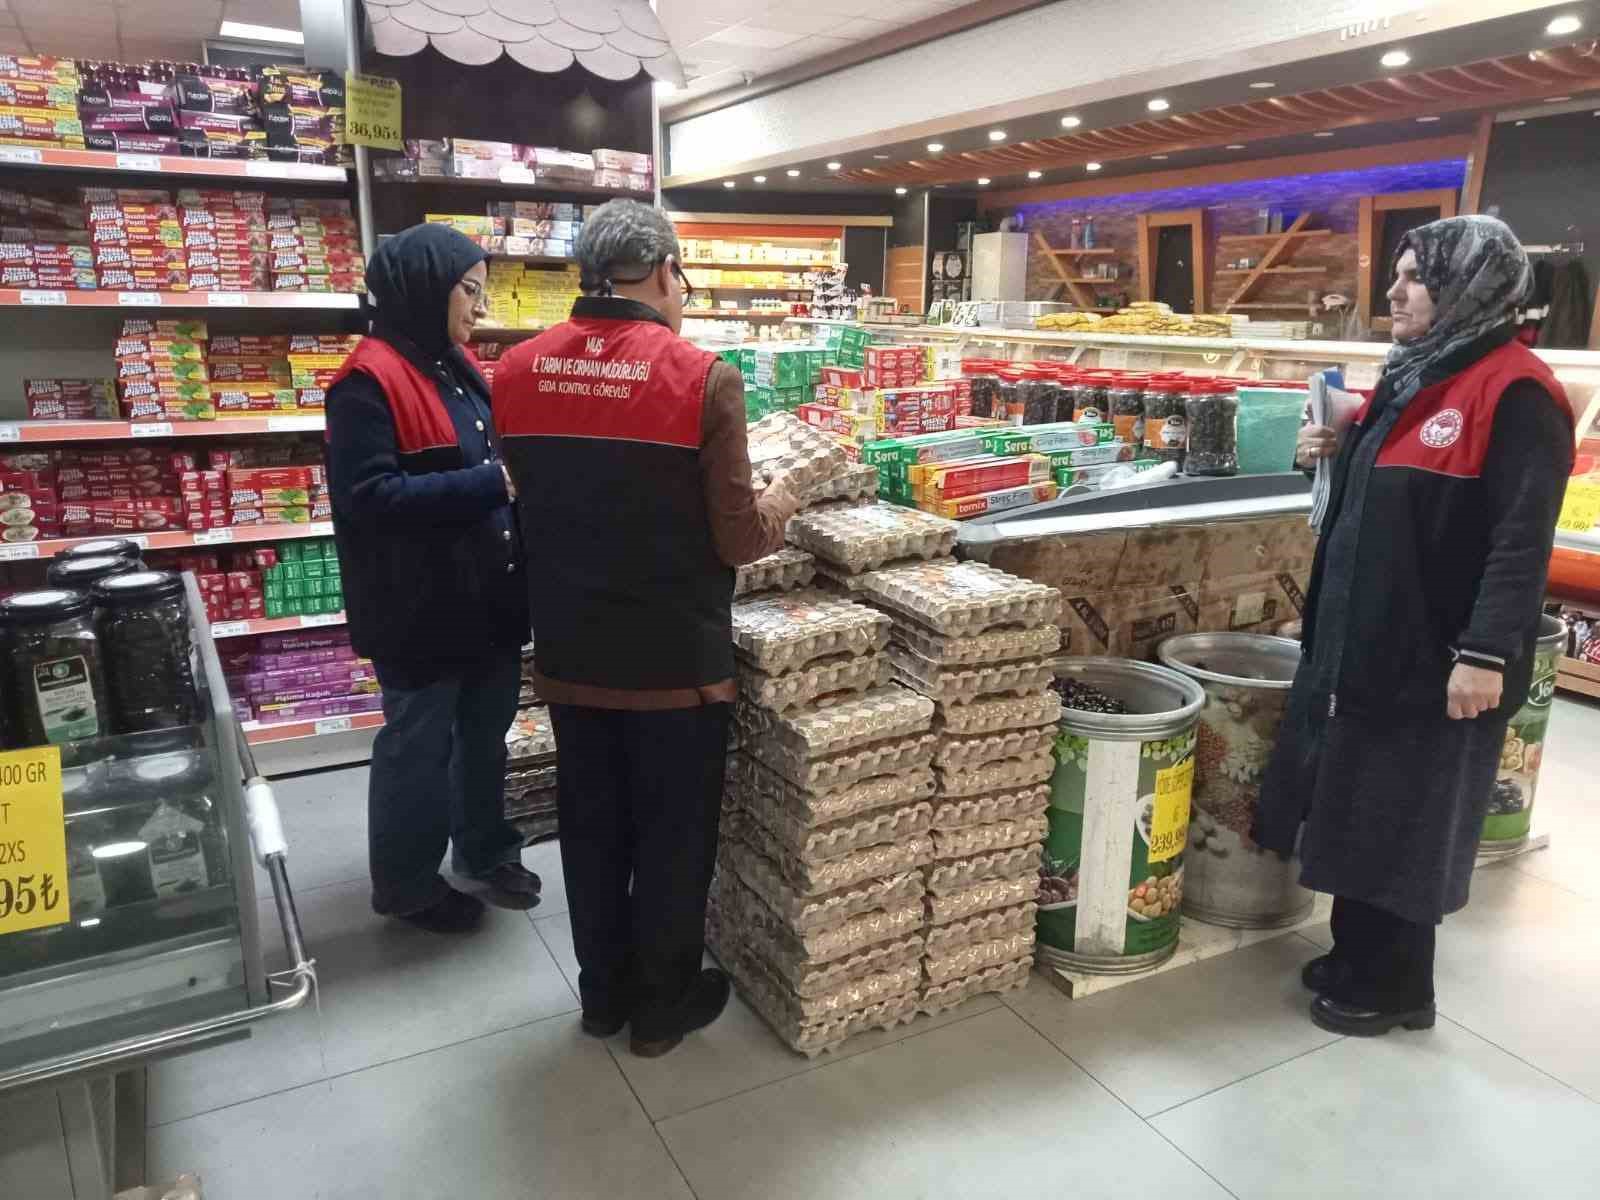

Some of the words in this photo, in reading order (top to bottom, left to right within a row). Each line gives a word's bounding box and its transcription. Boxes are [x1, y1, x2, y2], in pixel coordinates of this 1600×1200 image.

[563, 358, 574, 376] VE
[573, 360, 602, 377] ORMAN
[602, 359, 651, 381] MÜDÜRLÜĞÜ
[538, 380, 556, 393] GIDA
[559, 382, 591, 396] KONTROL
[593, 382, 632, 400] GÖREVLİSİ
[26, 762, 47, 783] GR
